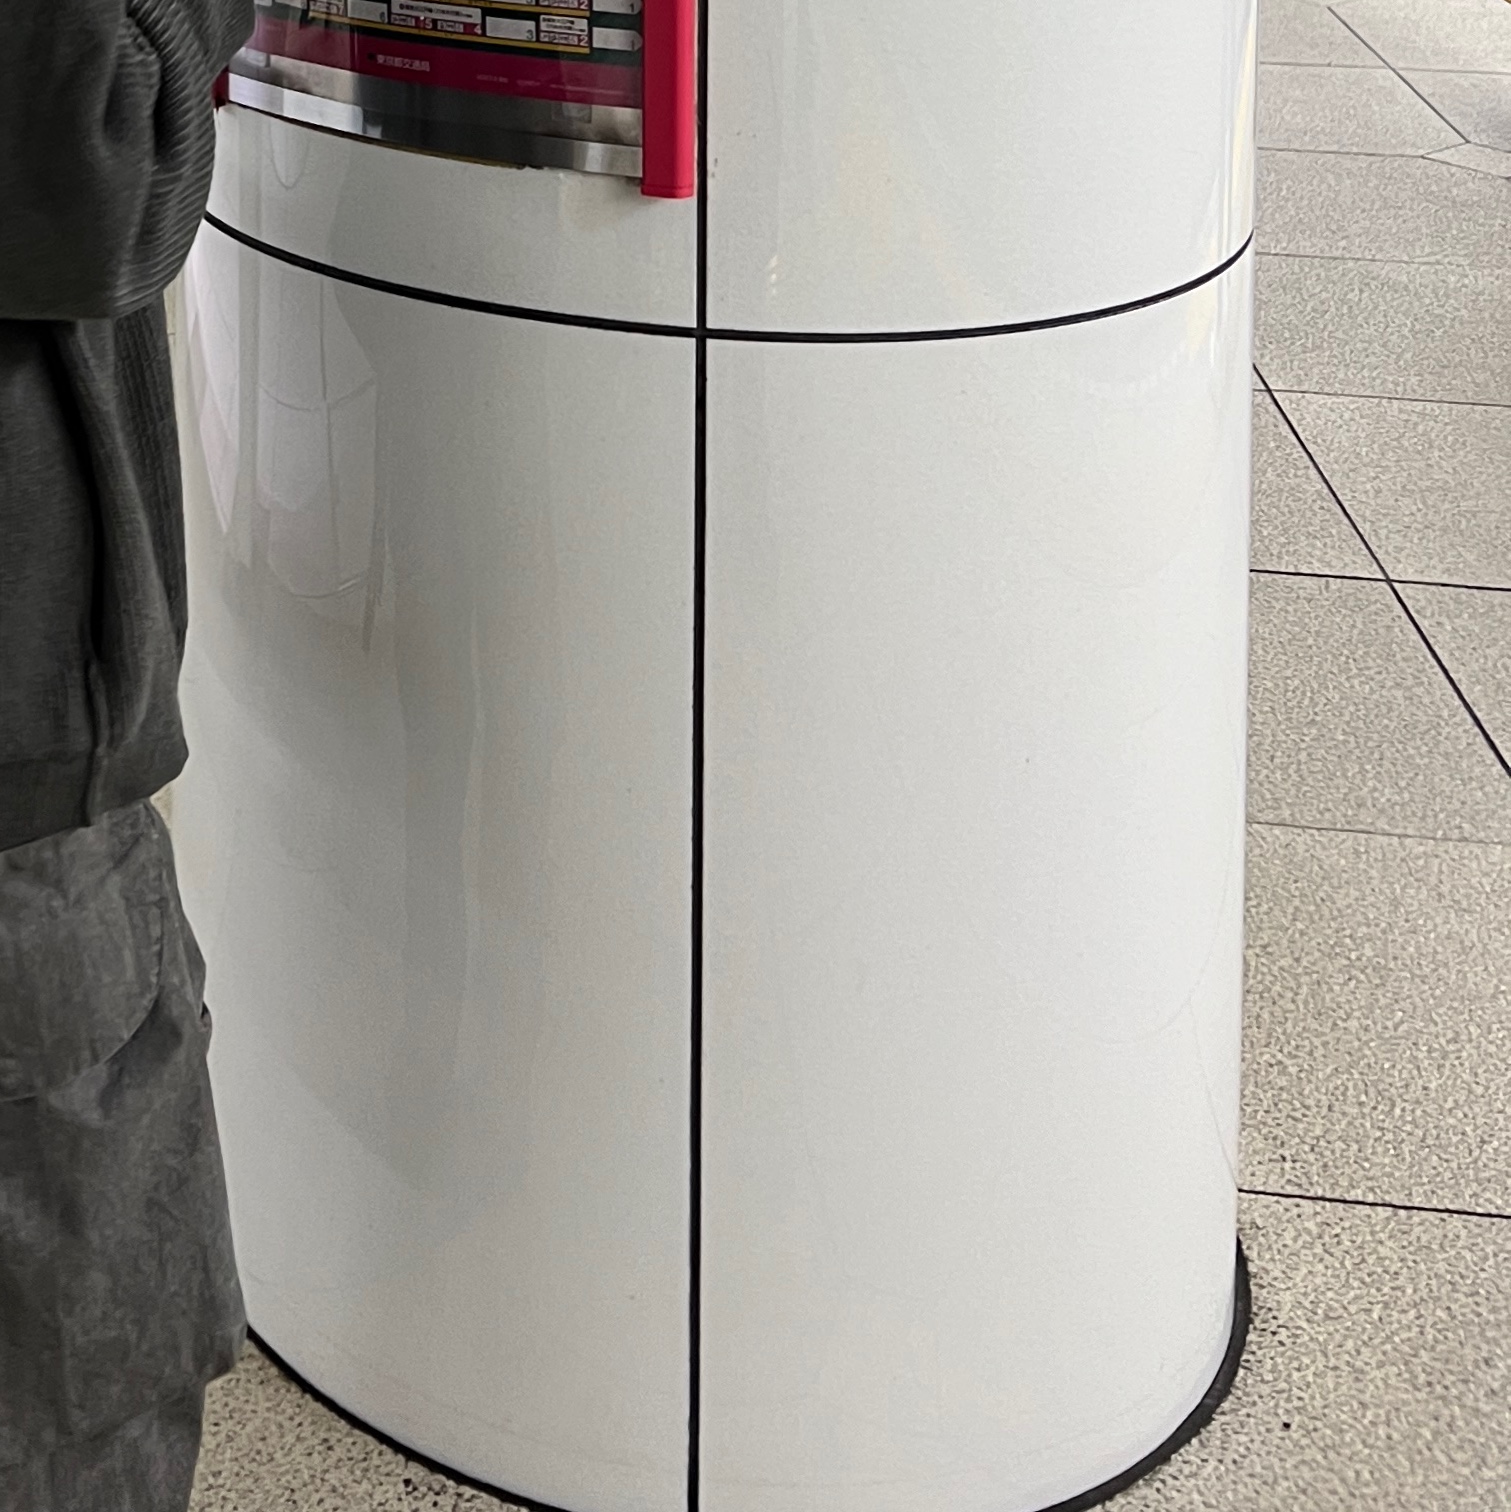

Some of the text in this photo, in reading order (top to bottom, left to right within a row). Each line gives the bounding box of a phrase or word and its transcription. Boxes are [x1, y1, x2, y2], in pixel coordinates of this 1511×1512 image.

[629, 3, 635, 13] 1
[425, 18, 482, 35] 5 4
